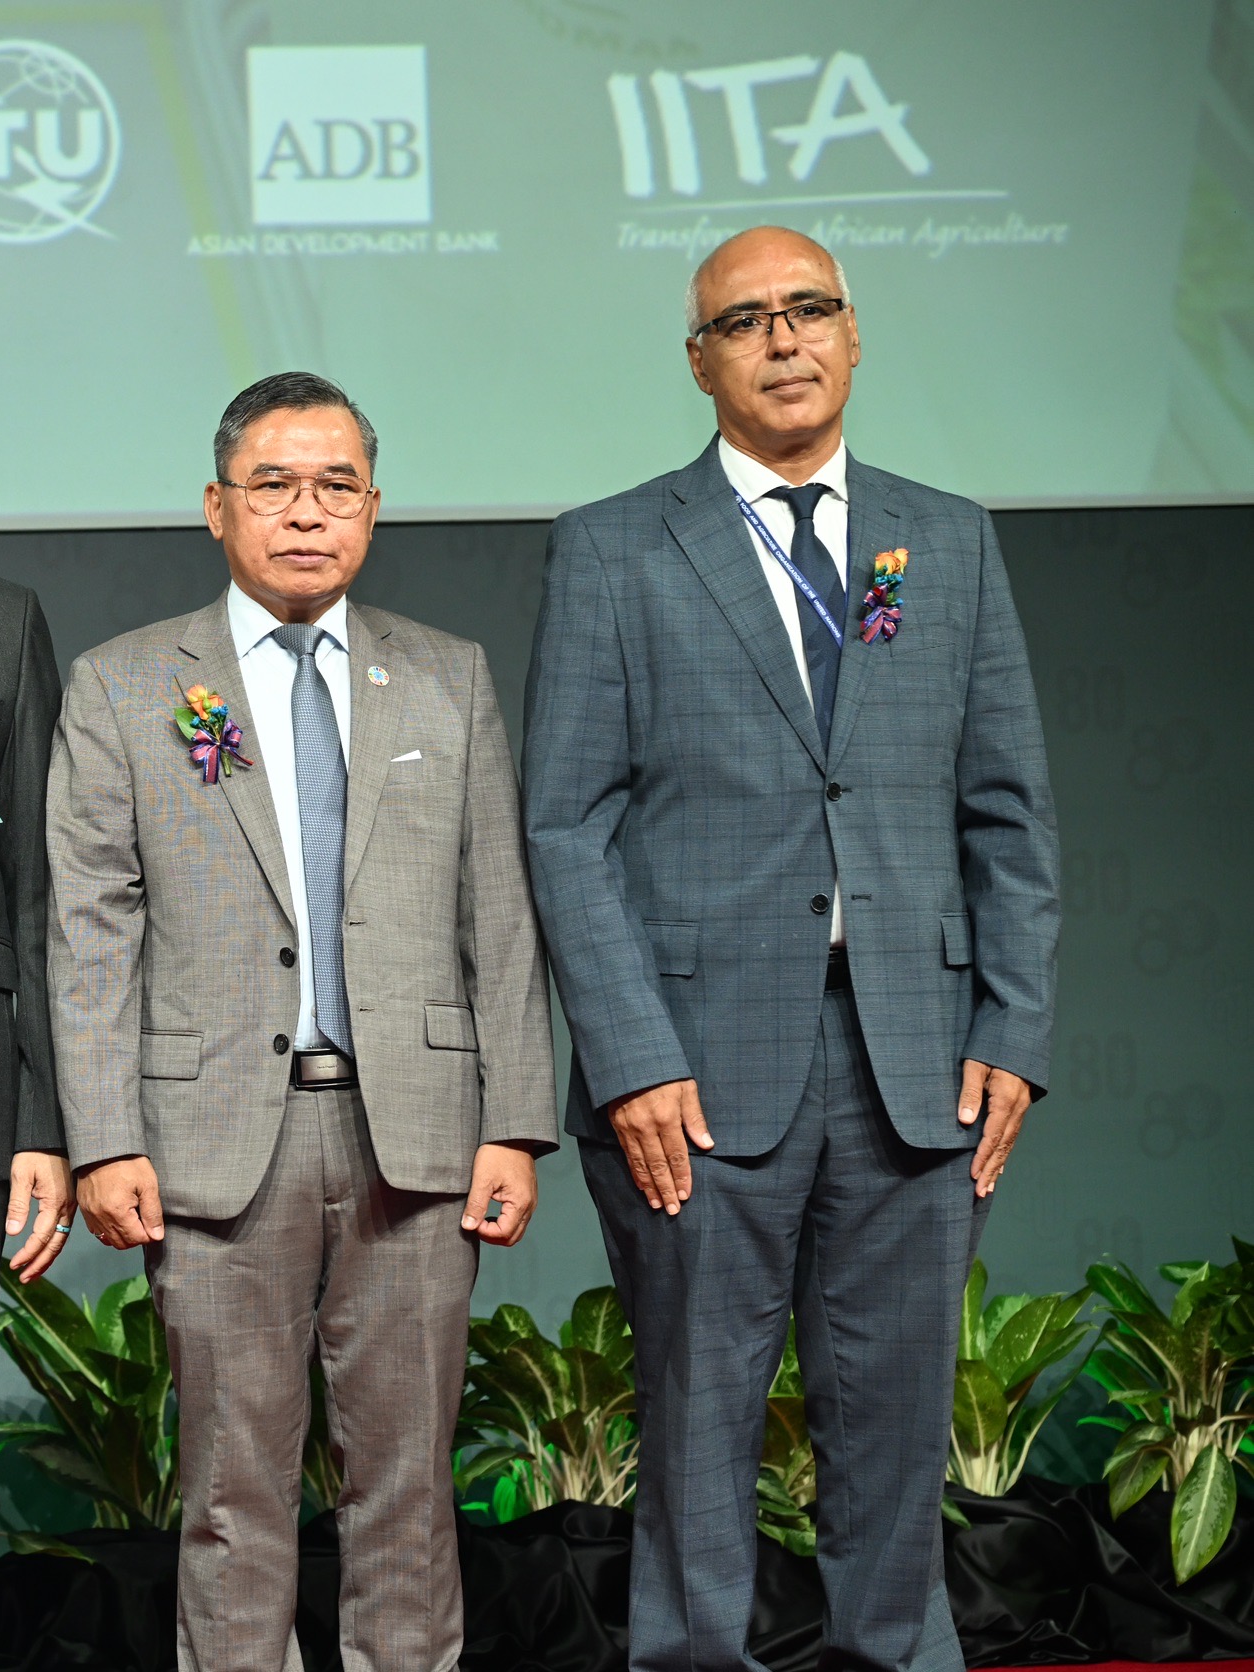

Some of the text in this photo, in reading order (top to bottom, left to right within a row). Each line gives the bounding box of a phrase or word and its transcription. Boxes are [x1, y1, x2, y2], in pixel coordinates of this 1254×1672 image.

[257, 118, 422, 182] ADB
[607, 51, 930, 197] IITA
[187, 230, 499, 255] ASIAN DEVELOPMENT BANK
[911, 213, 1069, 258] Agriculture
[740, 502, 751, 515] FOOD
[749, 515, 759, 525] AND
[757, 525, 777, 551] AGRICULTURE
[775, 550, 803, 584] ORGANIZATION
[807, 590, 816, 600] THE
[813, 599, 827, 616] UNITED
[825, 616, 842, 638] NATIONS
